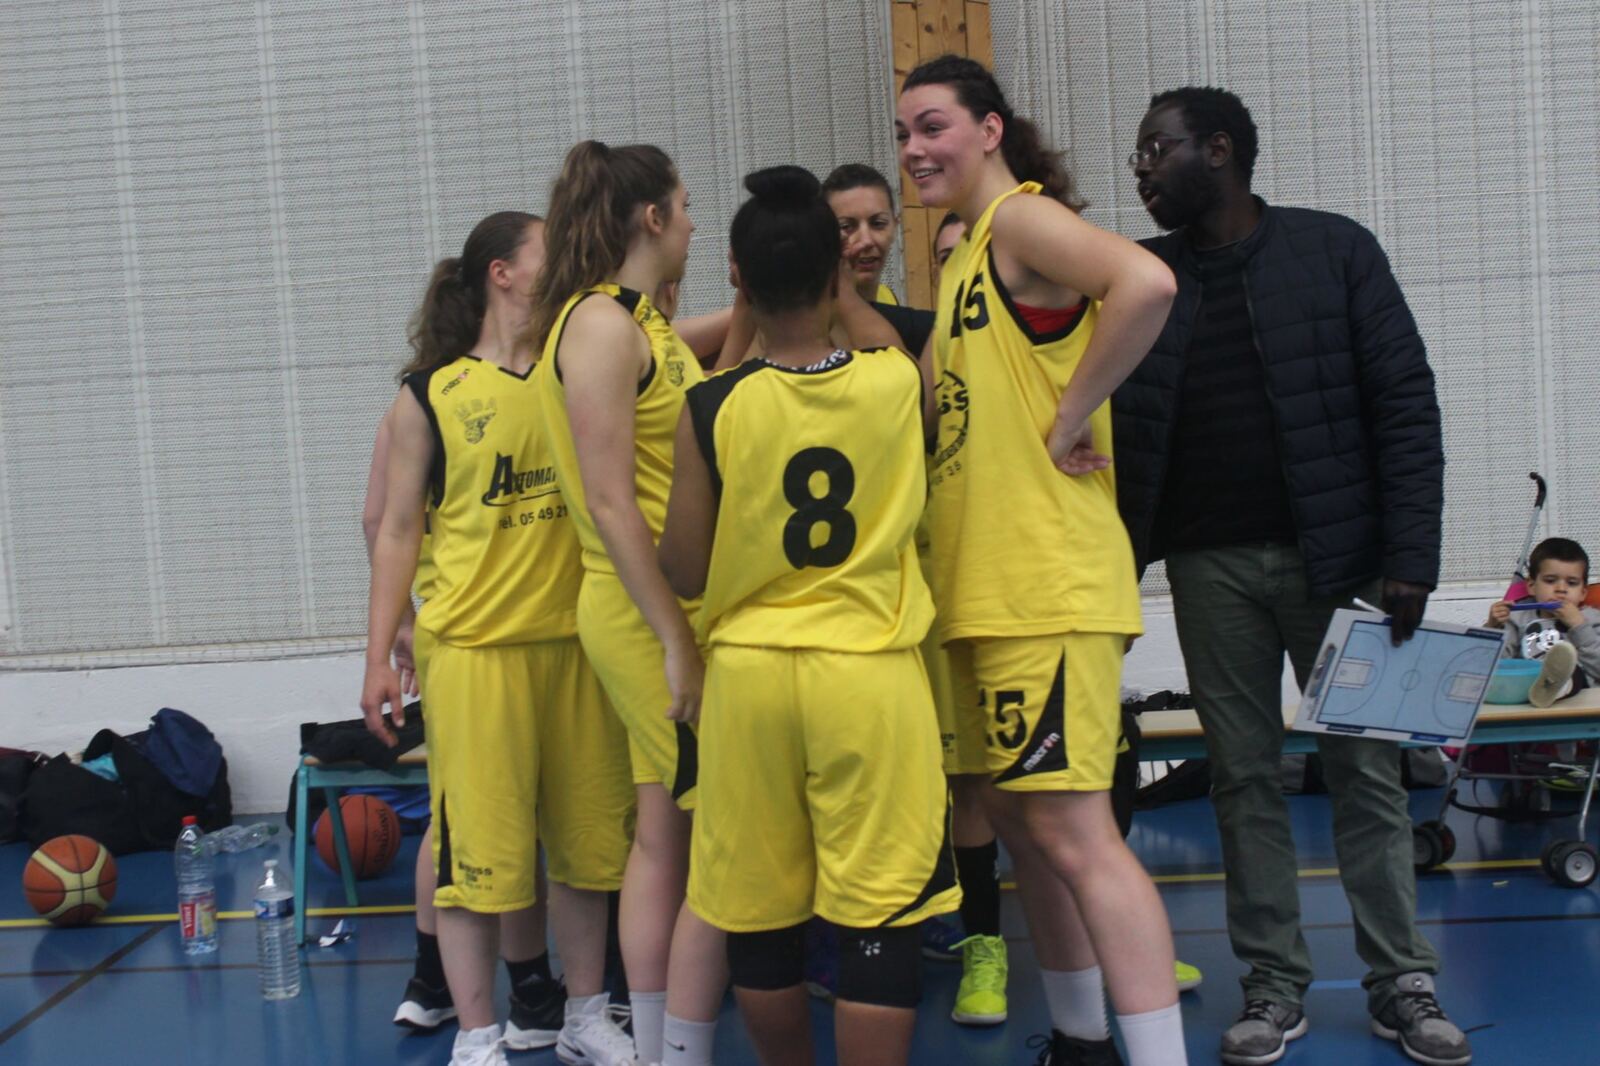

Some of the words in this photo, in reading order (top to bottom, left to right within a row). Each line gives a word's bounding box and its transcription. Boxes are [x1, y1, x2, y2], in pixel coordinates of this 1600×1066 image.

[519, 511, 535, 526] 05
[537, 507, 554, 520] 49
[783, 446, 857, 569] 8
